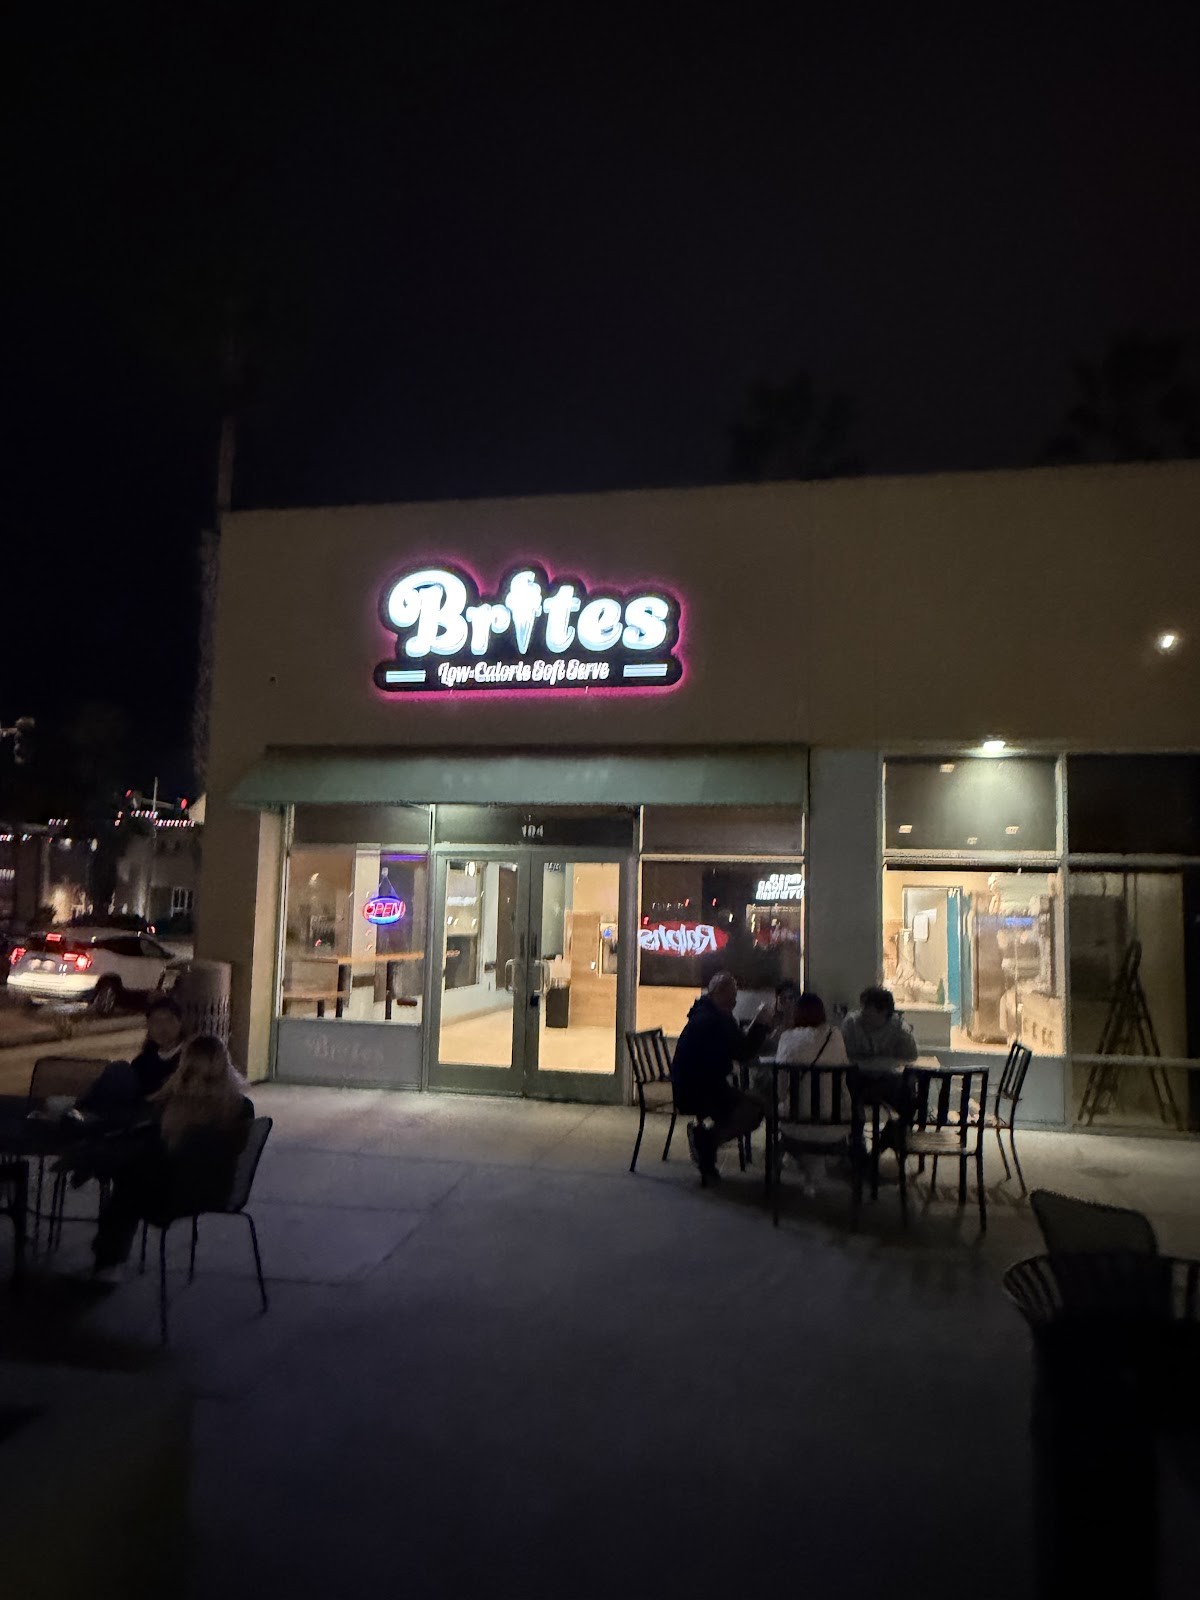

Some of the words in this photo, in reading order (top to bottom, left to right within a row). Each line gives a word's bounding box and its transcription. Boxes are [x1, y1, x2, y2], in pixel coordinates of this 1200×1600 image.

[438, 660, 531, 687] Low-Calorie
[531, 660, 565, 685] Soft
[566, 659, 610, 680] Serve
[522, 825, 543, 838] 104
[366, 900, 403, 918] OPEN
